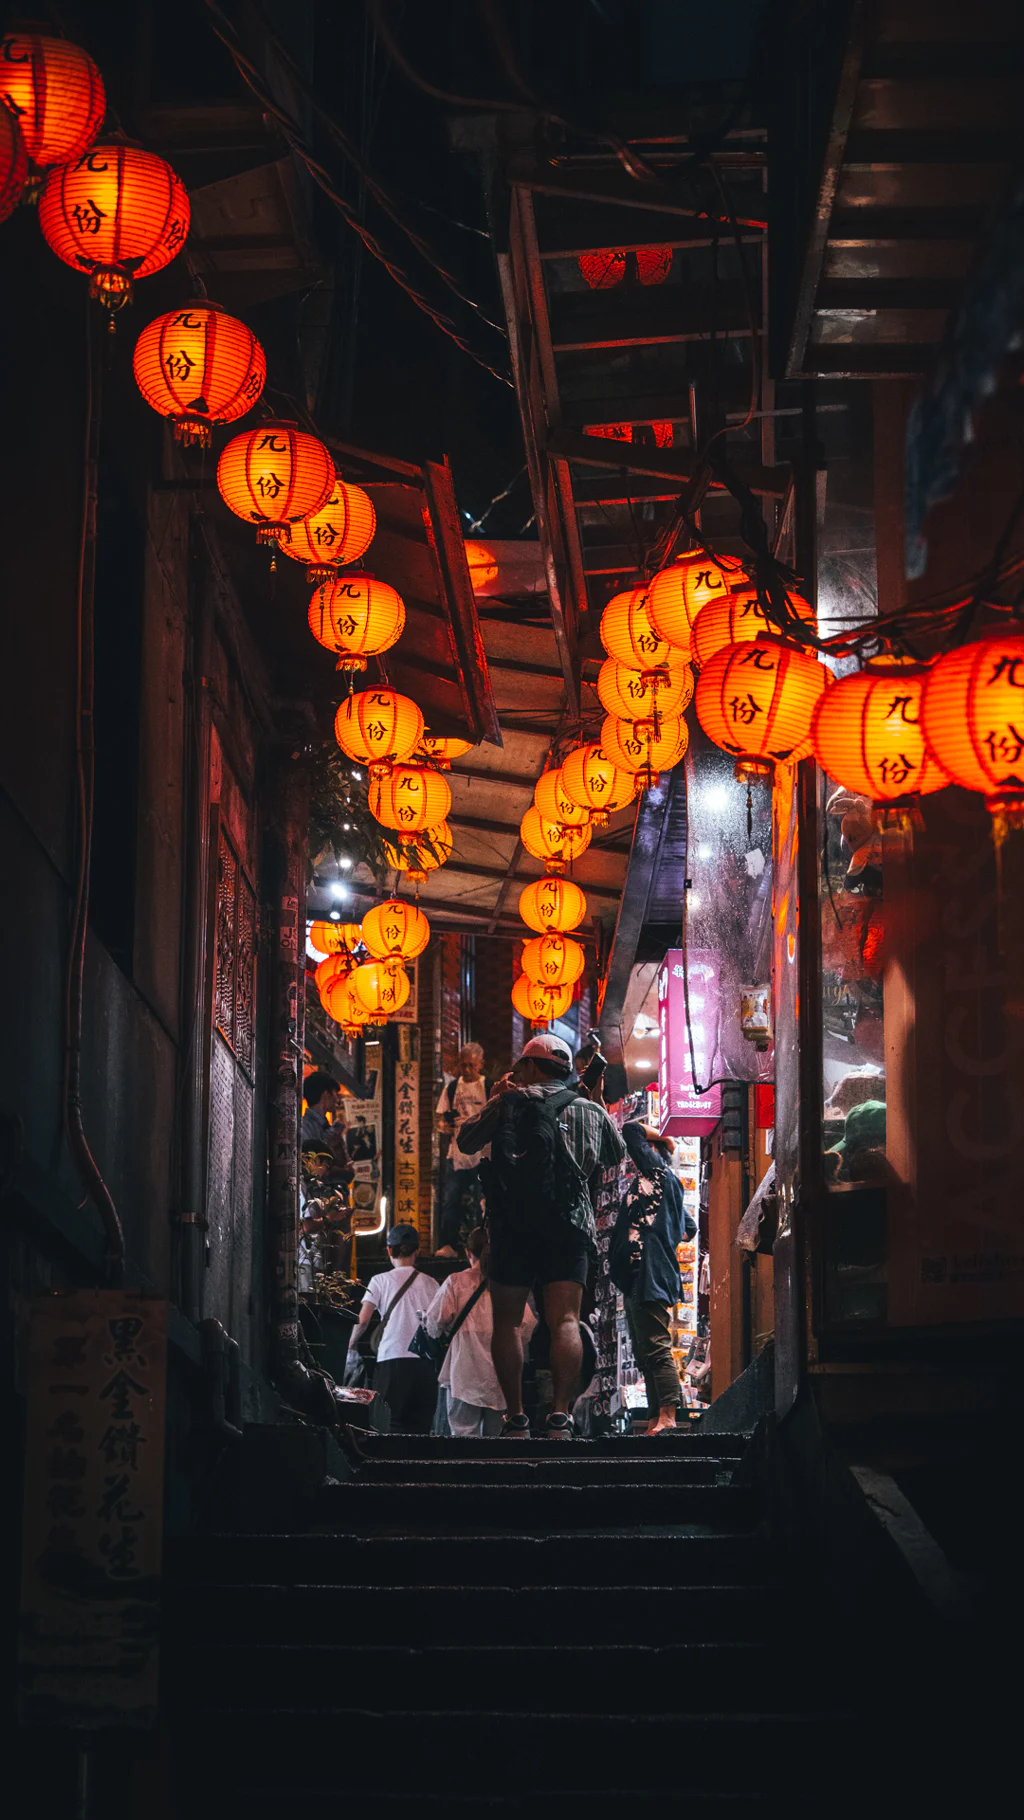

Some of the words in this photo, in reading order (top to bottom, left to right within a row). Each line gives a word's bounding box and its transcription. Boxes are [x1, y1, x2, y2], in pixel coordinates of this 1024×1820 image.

[71, 151, 109, 235] 九份
[165, 312, 201, 381] 九份
[256, 434, 287, 500] 九份
[336, 583, 361, 637] 九份
[366, 693, 391, 741] 九份
[729, 649, 774, 725] 九份
[984, 655, 1024, 764] 九份
[878, 696, 918, 784] 九份
[398, 777, 419, 822] 九份
[589, 748, 608, 793] 九份
[386, 904, 402, 940] 九份
[540, 881, 558, 918] 九份
